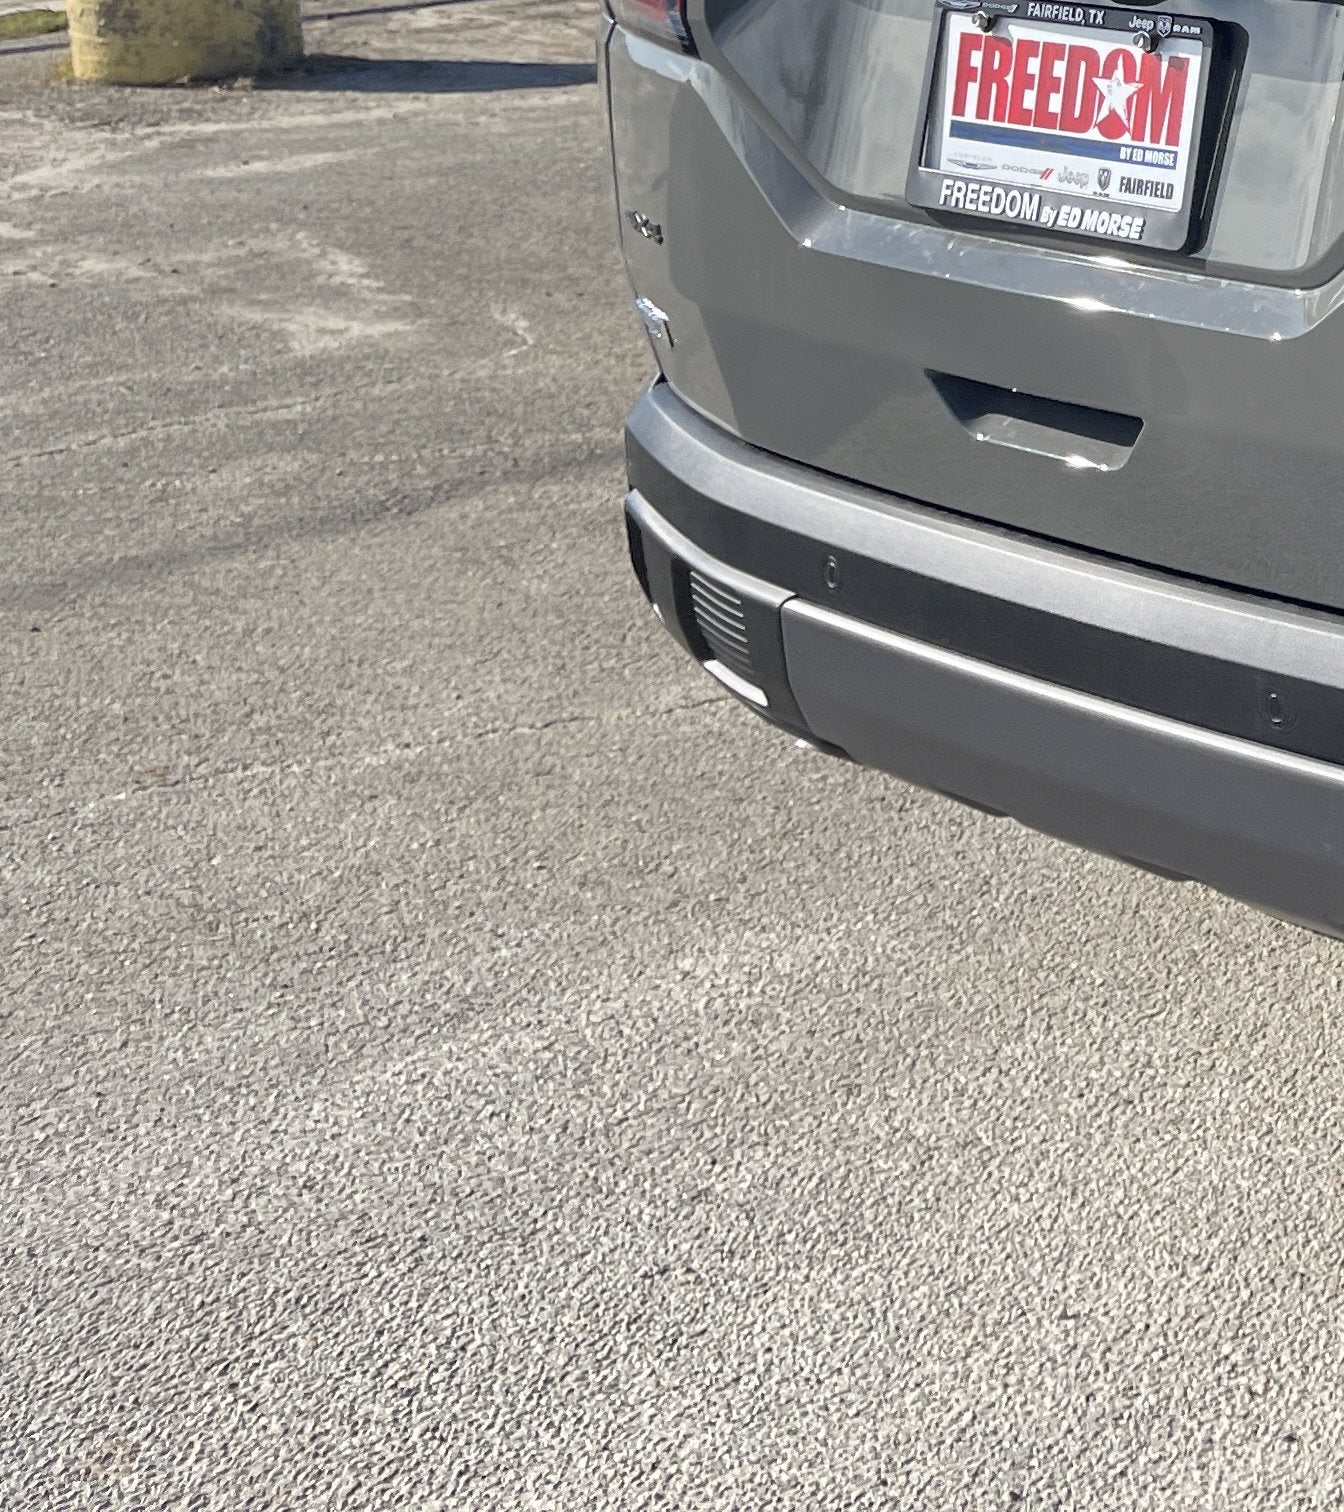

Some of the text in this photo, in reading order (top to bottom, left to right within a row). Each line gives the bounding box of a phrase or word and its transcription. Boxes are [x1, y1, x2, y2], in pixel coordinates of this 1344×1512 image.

[1027, 1, 1106, 26] FAIRFIELD, TX
[1128, 15, 1155, 32] Jeep
[1172, 25, 1201, 35] RAM
[951, 32, 1191, 147] FREEDOM
[1120, 146, 1175, 167] BY ED MORSE
[1057, 166, 1090, 189] Jeep
[1119, 176, 1175, 200] FAIRFIELD
[939, 179, 1041, 222] FREEDOM
[1058, 204, 1083, 228] ED
[1082, 209, 1146, 240] MORSE
